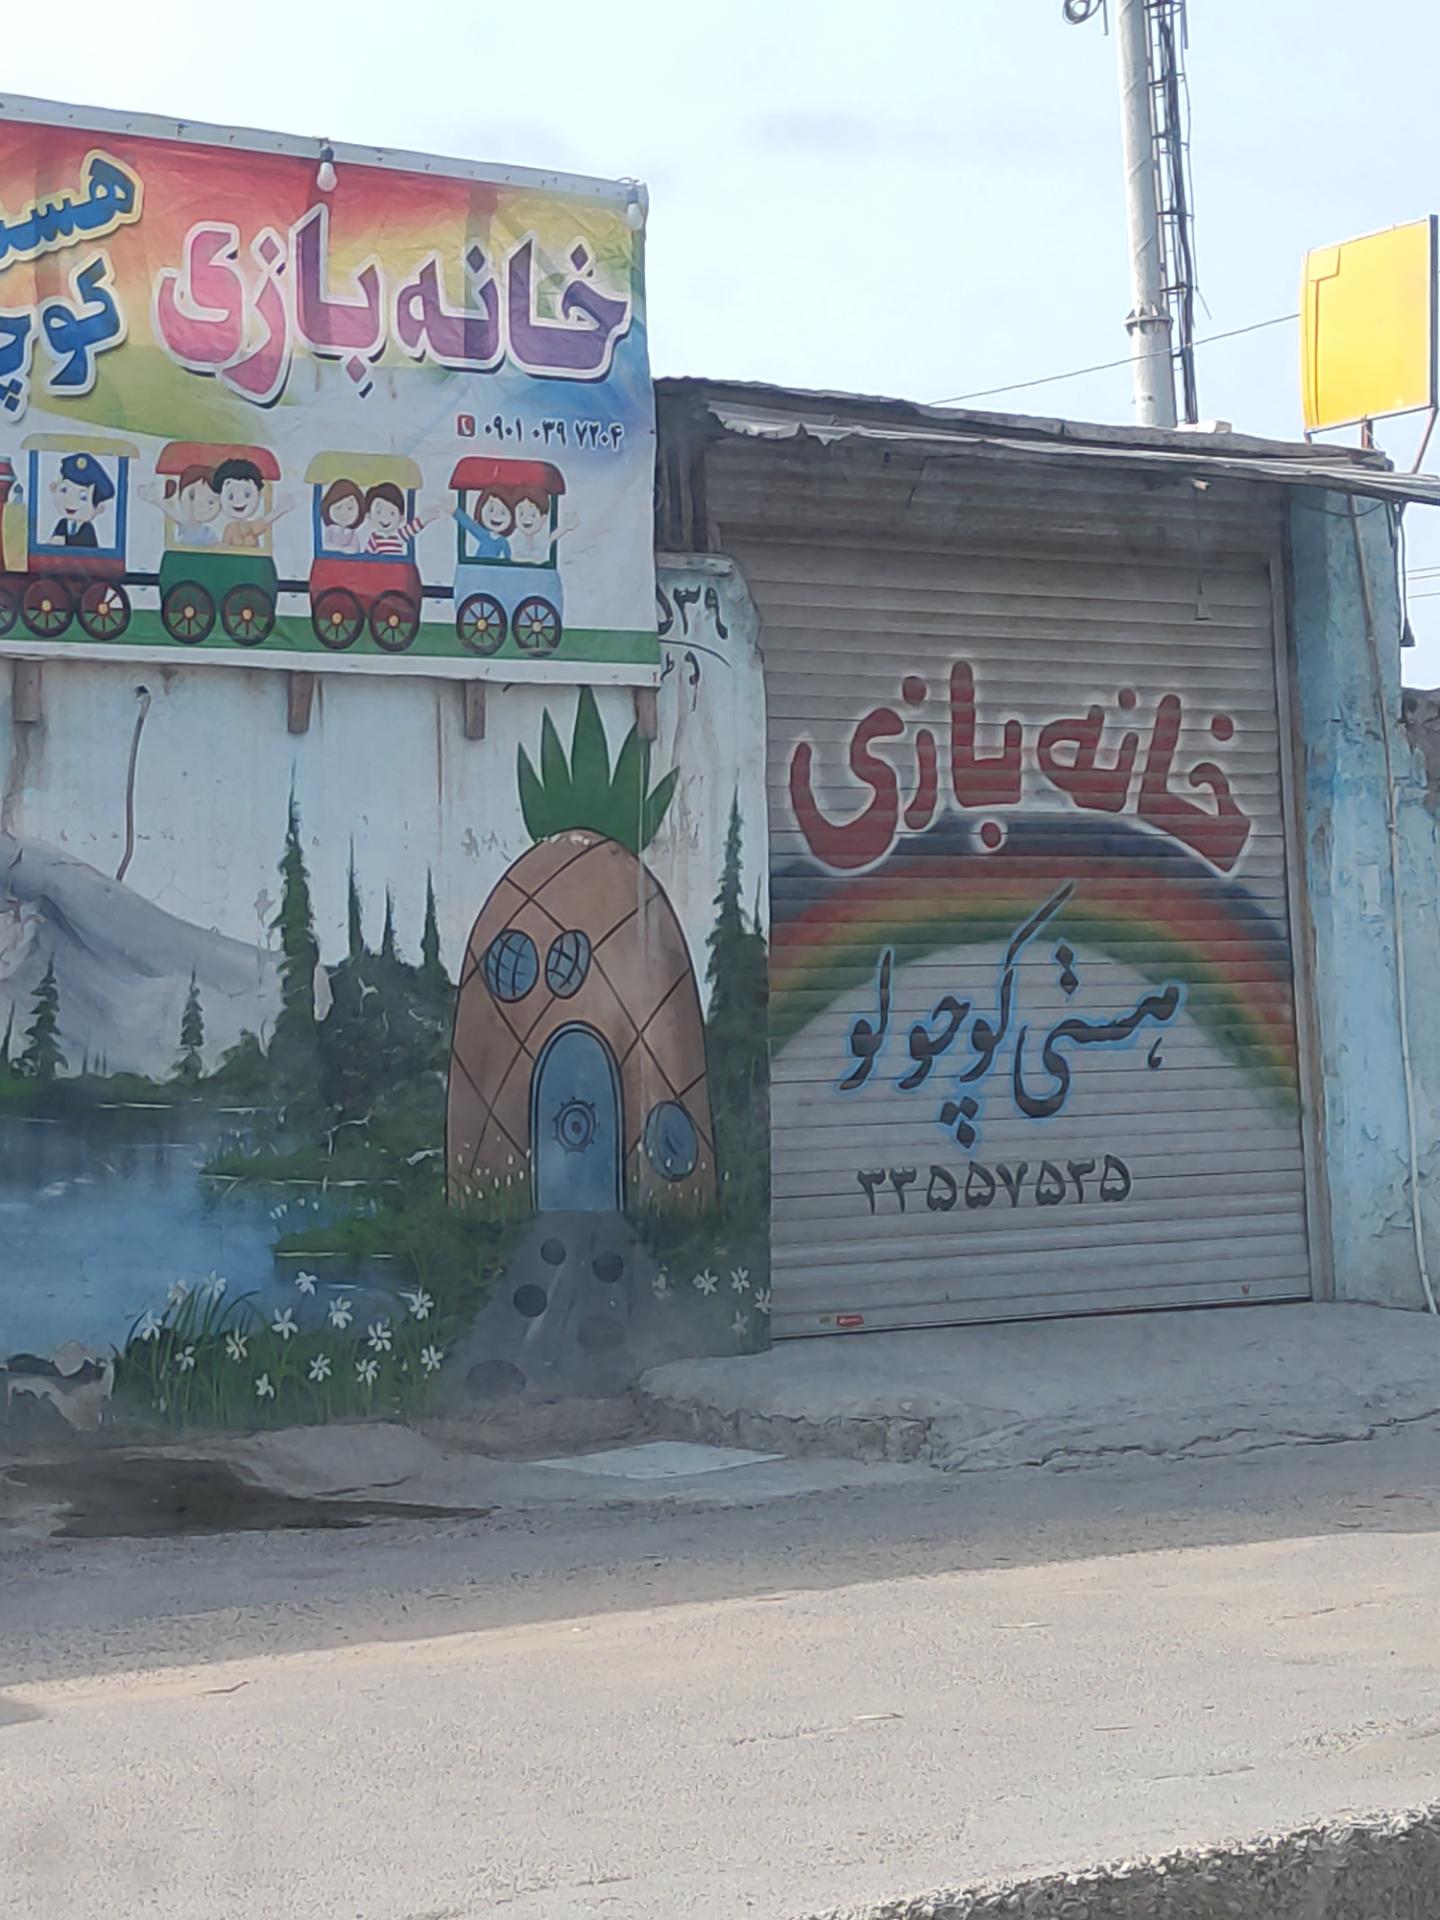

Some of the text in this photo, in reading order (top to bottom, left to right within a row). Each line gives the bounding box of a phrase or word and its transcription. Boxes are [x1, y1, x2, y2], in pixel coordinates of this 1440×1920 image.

[156, 207, 628, 402] خانه بازی
[789, 660, 1251, 872] خانه بازی
[839, 880, 1180, 1149] هستی کوچولو
